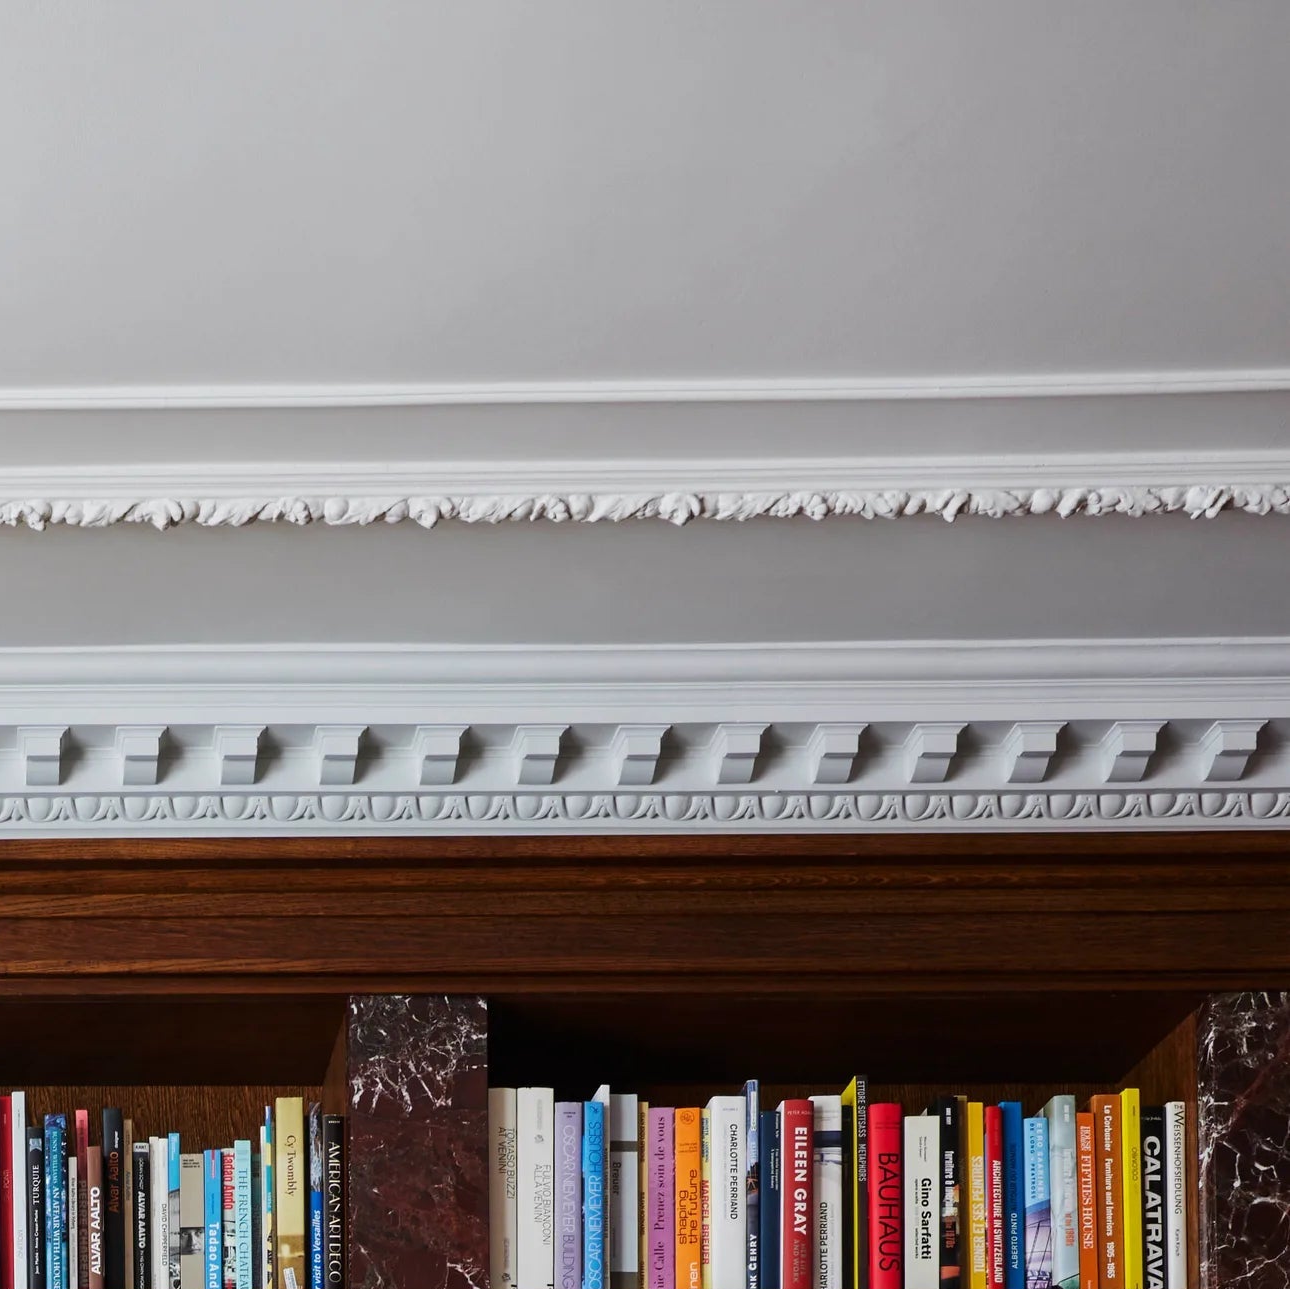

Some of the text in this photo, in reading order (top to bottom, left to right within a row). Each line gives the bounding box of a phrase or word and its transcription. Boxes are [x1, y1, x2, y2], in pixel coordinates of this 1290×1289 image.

[285, 1135, 297, 1196] Cy Twombly
[730, 1124, 739, 1220] CHARLOTTE PERRIAND
[794, 1127, 807, 1235] EILEEN GRAY
[878, 1152, 900, 1272] BAUHAUS
[1082, 1155, 1093, 1249] FIFTIES HOUSE
[920, 1178, 932, 1259] Gino Sarfatti
